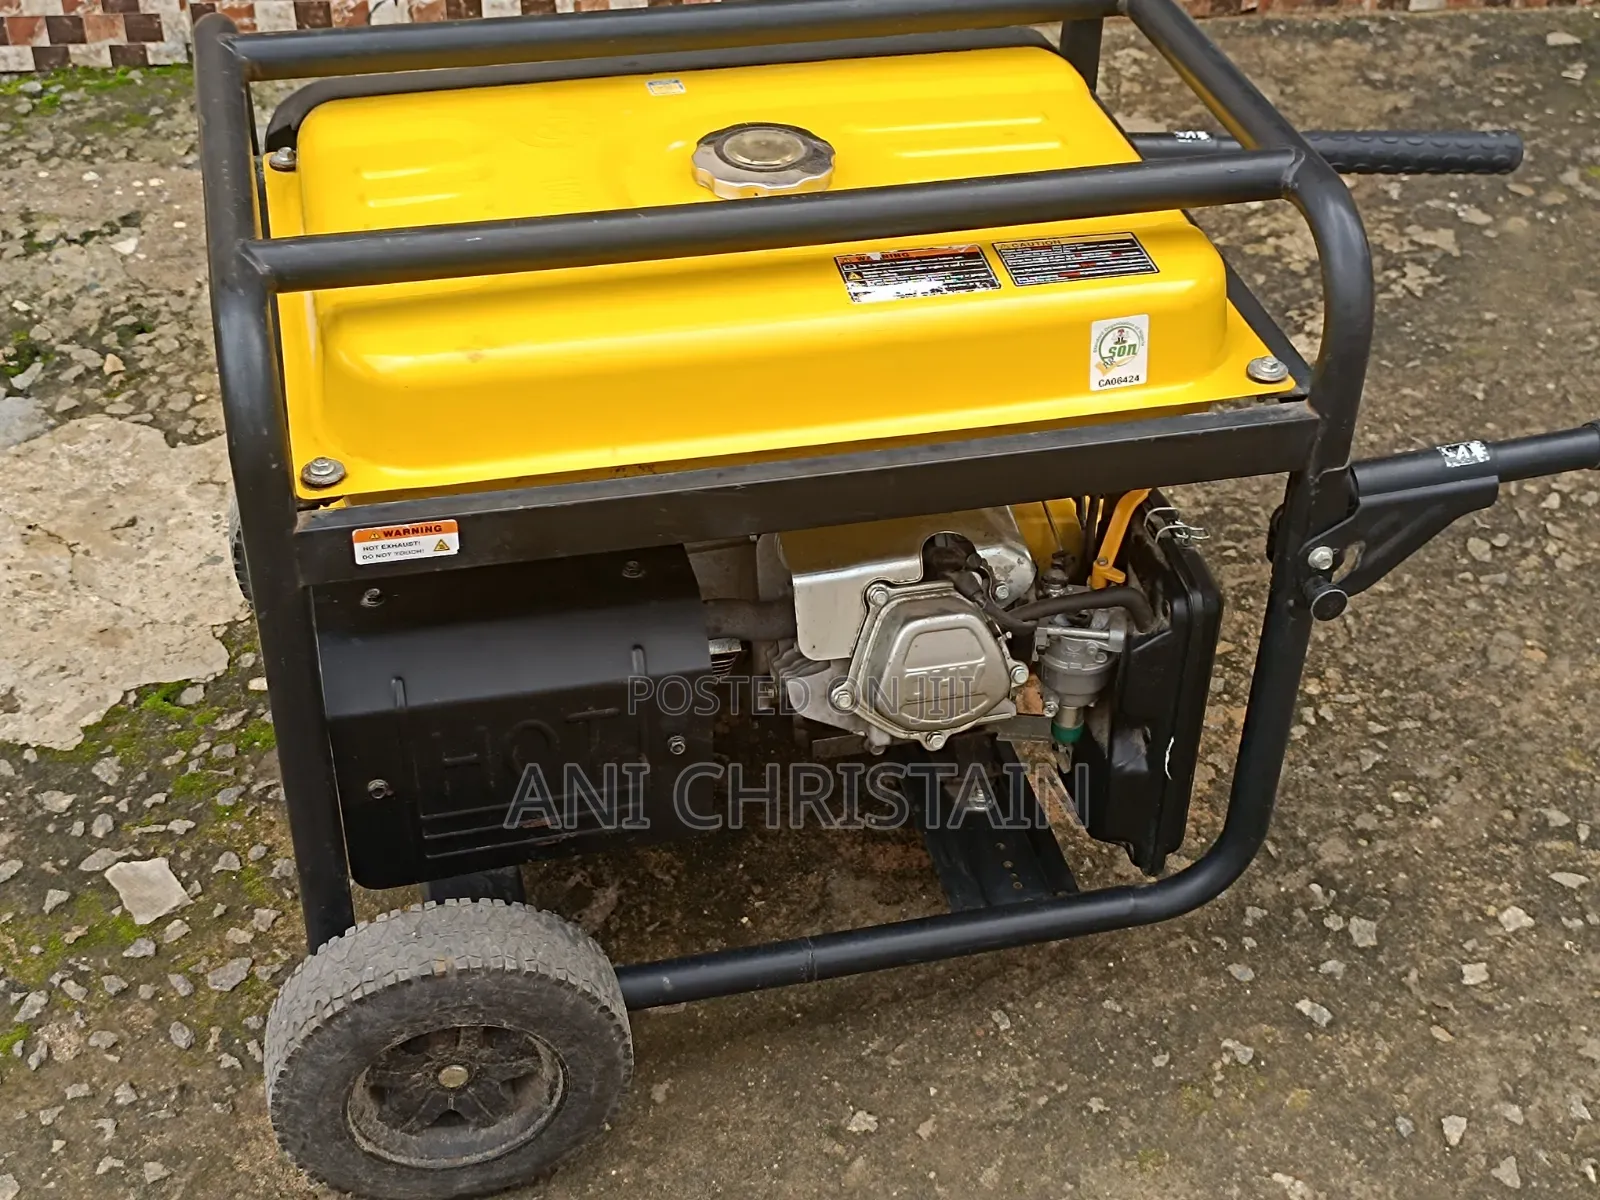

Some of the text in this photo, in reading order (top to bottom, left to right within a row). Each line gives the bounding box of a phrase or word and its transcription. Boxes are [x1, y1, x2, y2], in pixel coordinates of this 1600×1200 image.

[1011, 239, 1061, 248] CAUTION
[856, 252, 910, 262] WANING
[1098, 374, 1140, 388] CA06424
[383, 524, 443, 538] WARNING
[381, 540, 421, 550] EXHAUST!
